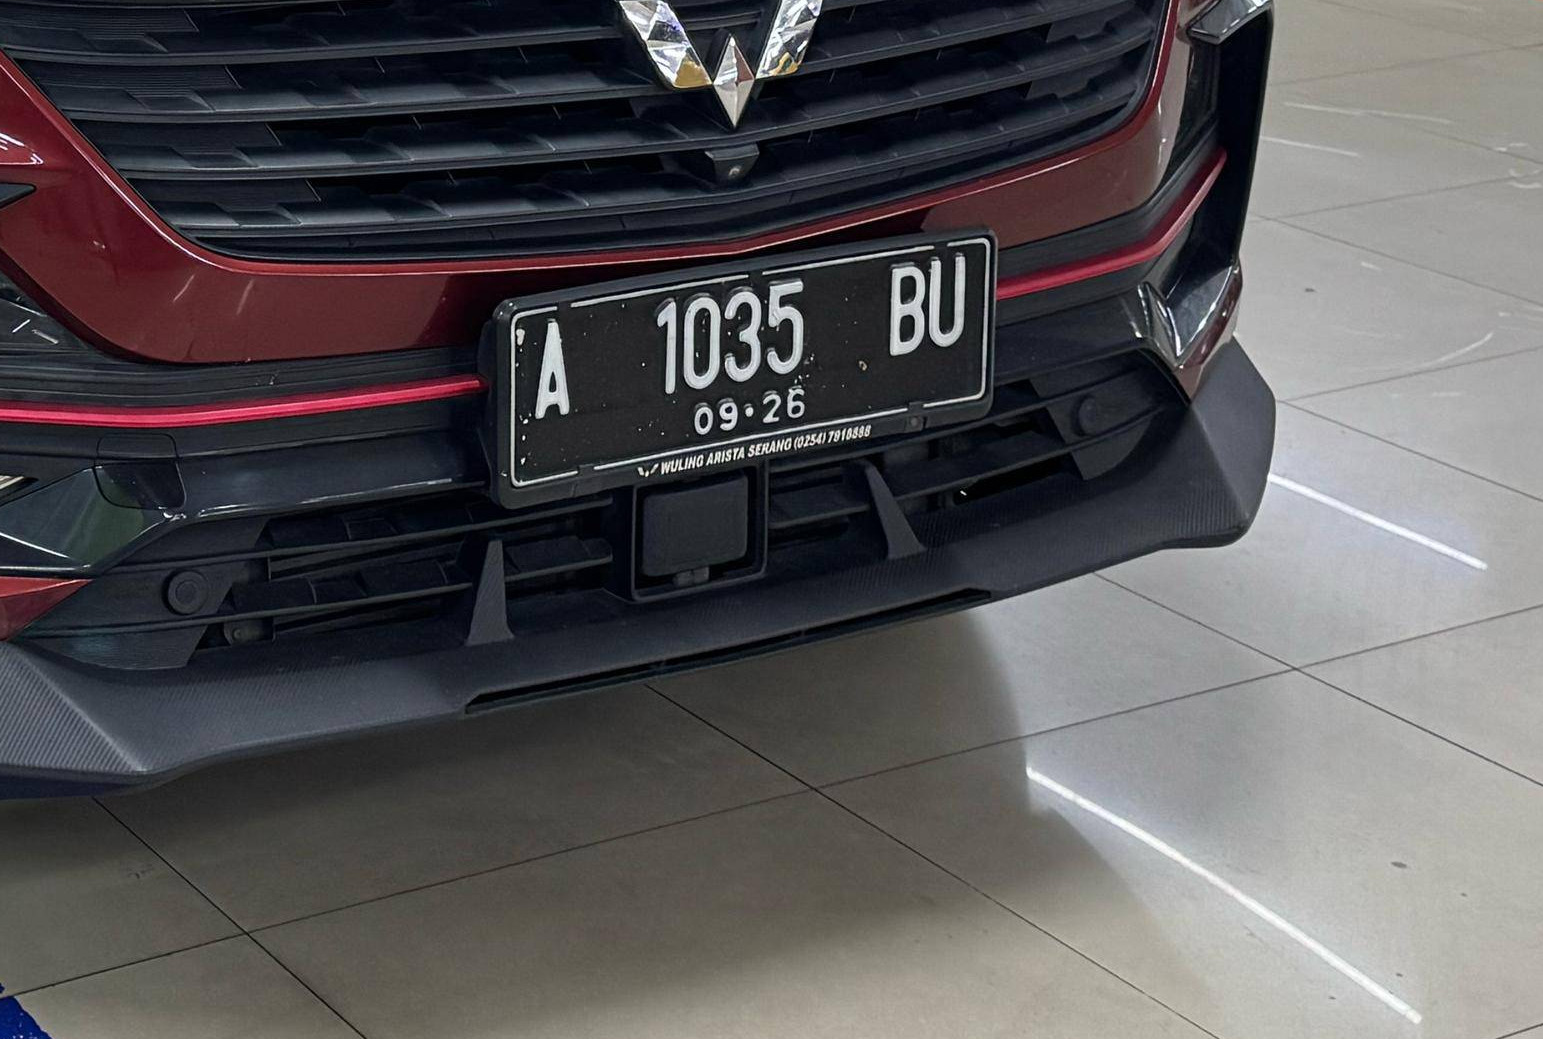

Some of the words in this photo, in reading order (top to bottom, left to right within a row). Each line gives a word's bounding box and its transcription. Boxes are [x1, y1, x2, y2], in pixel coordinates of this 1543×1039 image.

[534, 318, 570, 420] A
[656, 278, 805, 395] 1035
[888, 252, 967, 357] BU
[660, 456, 704, 475] WULING
[706, 446, 745, 466] ARISTA
[747, 437, 792, 458] SERANG
